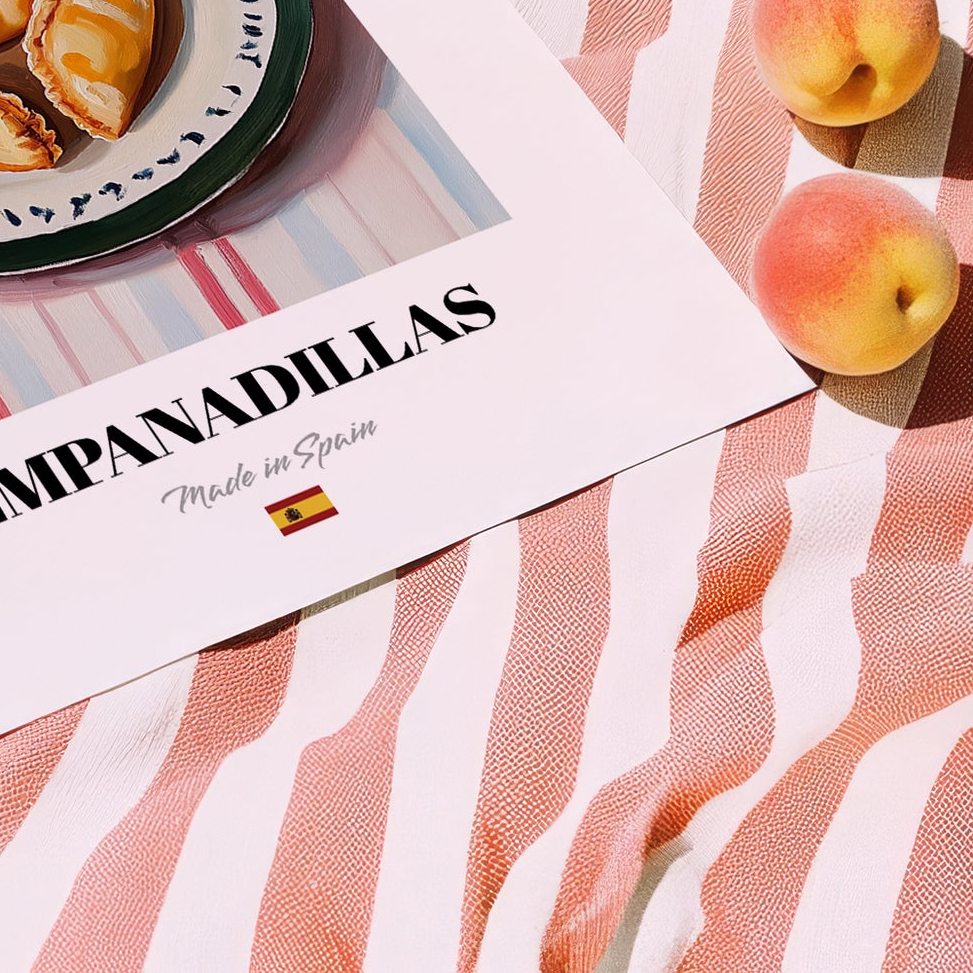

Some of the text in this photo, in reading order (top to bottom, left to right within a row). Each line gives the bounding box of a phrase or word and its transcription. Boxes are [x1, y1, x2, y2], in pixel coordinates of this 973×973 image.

[160, 419, 378, 514] Made in Spain
